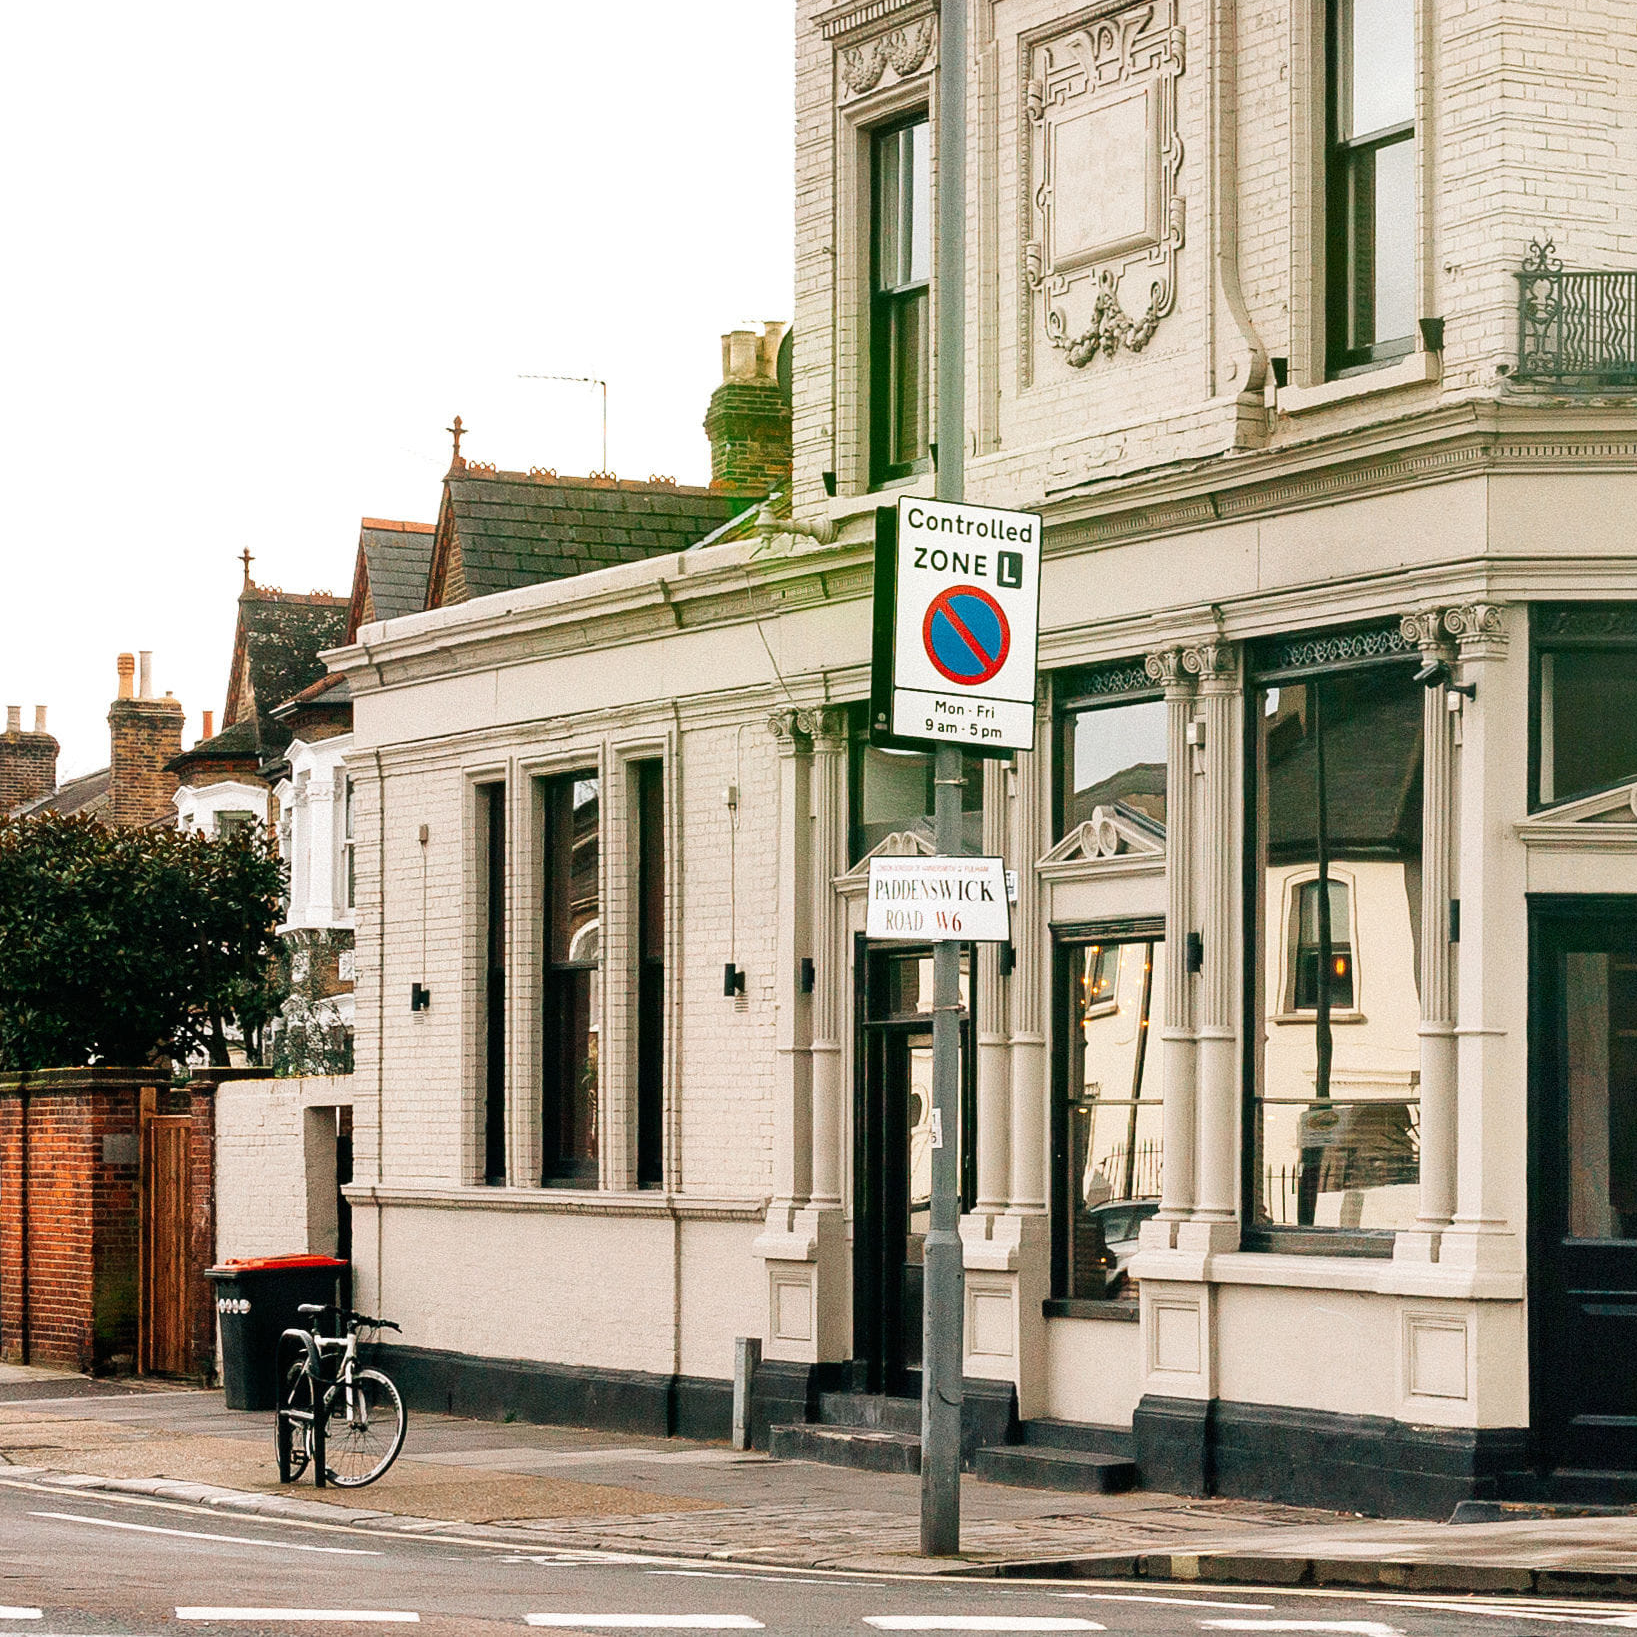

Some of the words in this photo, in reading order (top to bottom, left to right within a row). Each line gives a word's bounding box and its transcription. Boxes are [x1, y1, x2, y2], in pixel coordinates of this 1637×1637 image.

[908, 508, 1032, 544] Controlled
[914, 547, 988, 577] ZONE
[935, 700, 965, 716] Mon
[977, 705, 995, 719] Fri
[925, 718, 934, 731] 9
[937, 723, 957, 733] am
[970, 723, 978, 736] 5
[982, 727, 1002, 739] pm
[875, 879, 995, 902] PADDENSWICK
[886, 909, 924, 932] ROAD
[936, 910, 963, 932] W6
